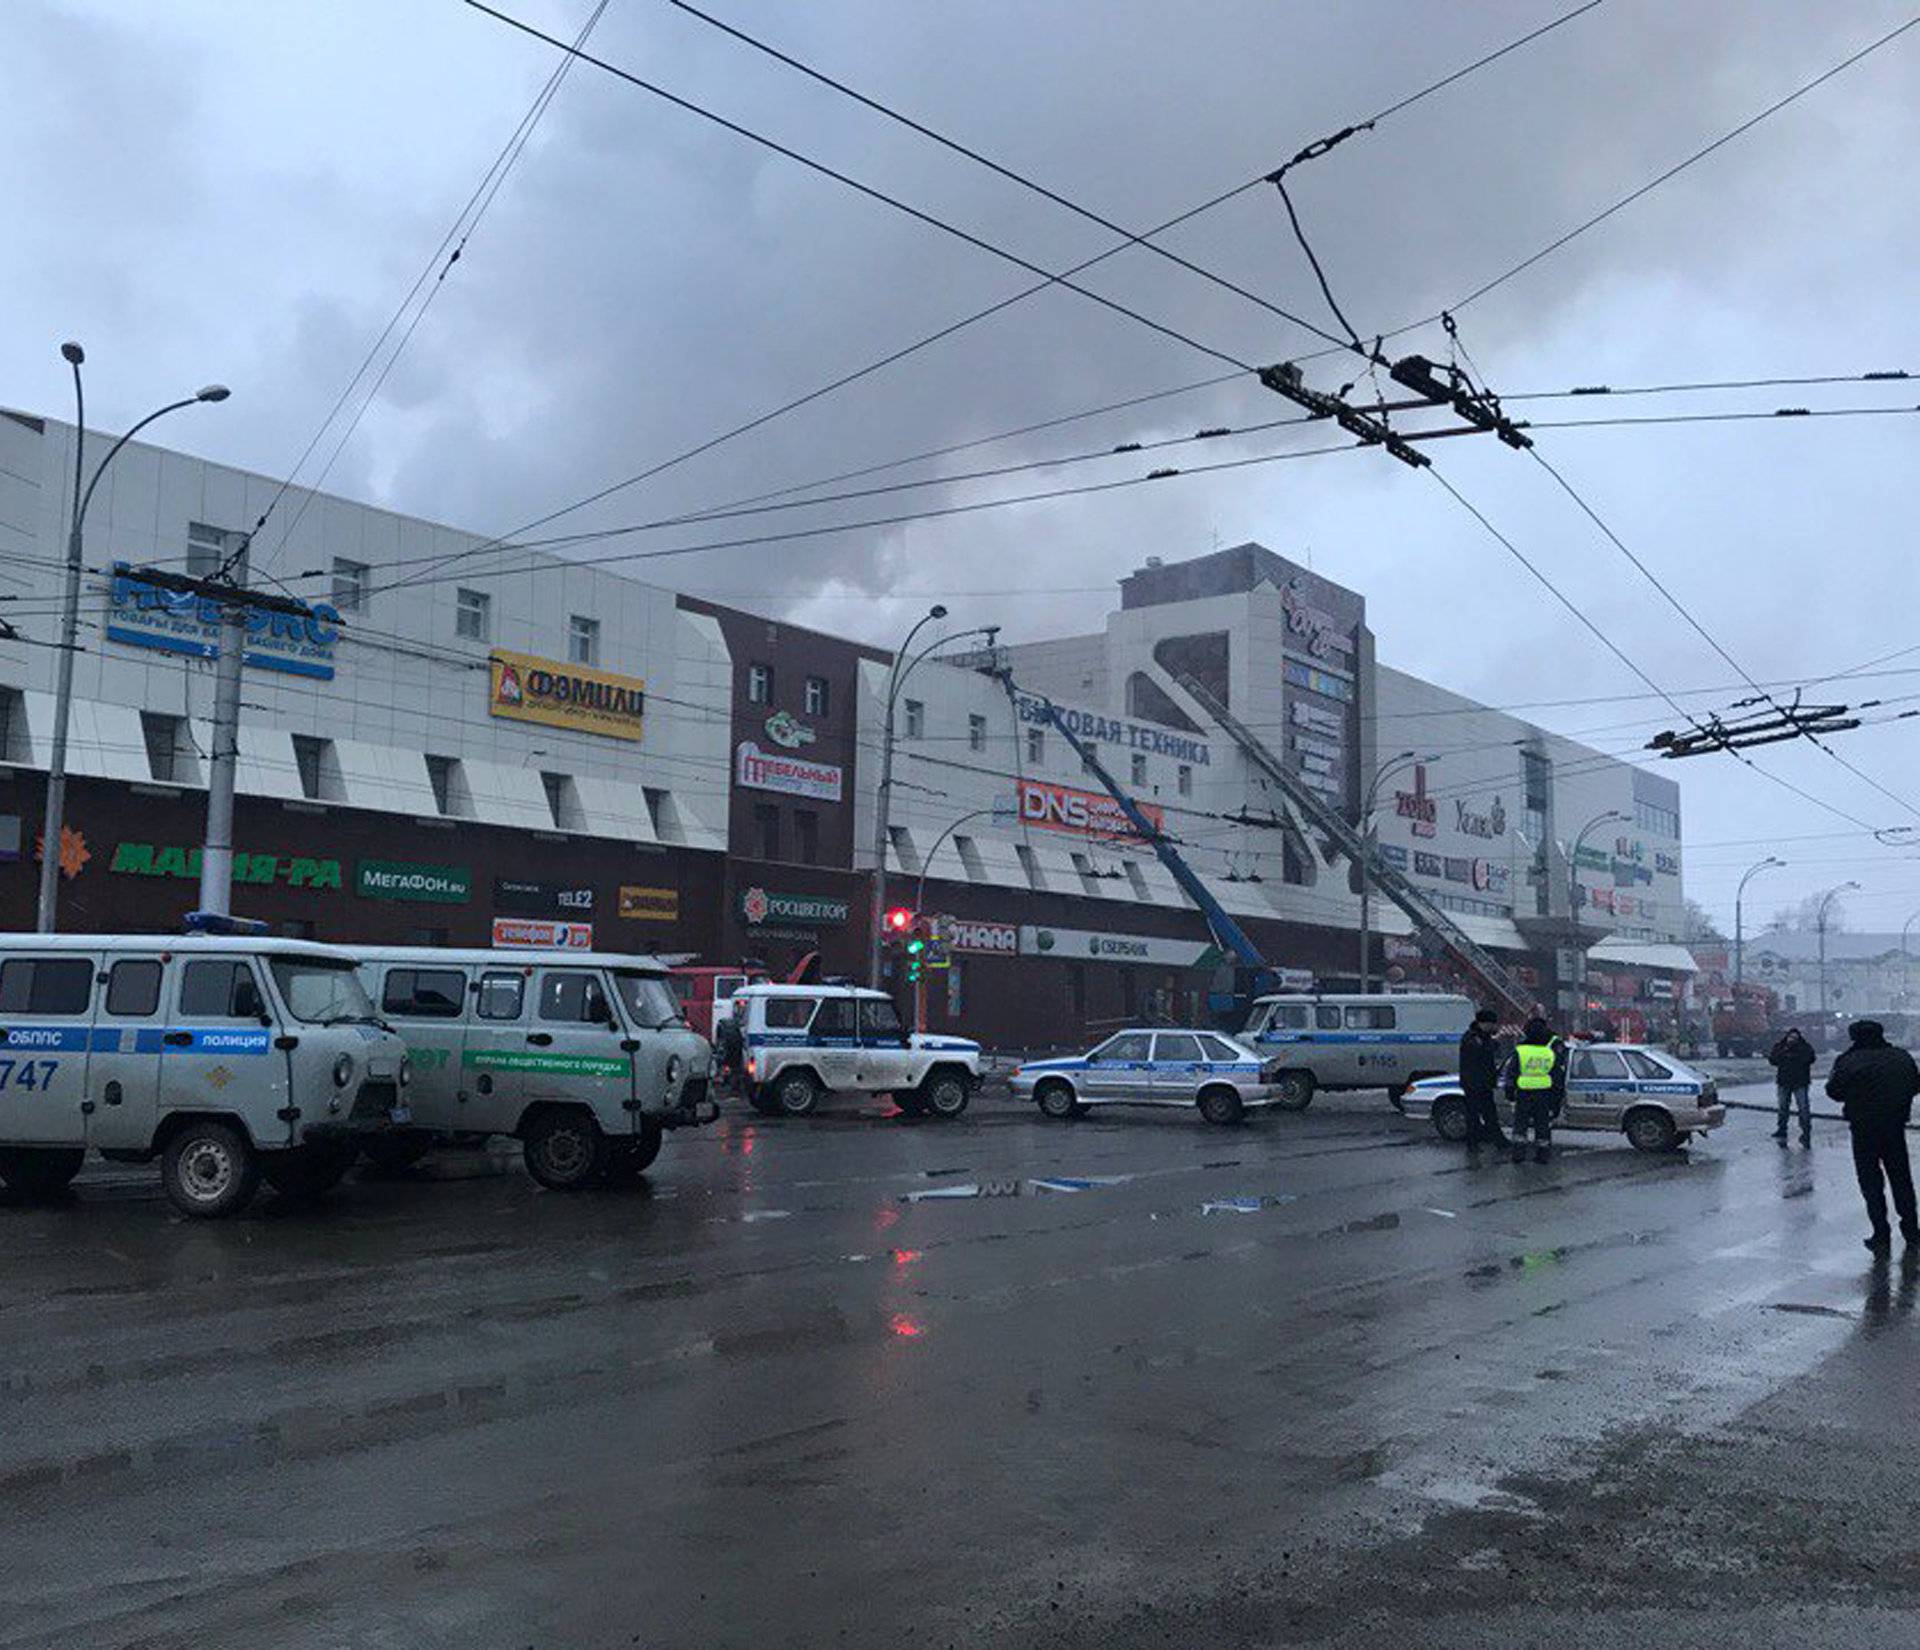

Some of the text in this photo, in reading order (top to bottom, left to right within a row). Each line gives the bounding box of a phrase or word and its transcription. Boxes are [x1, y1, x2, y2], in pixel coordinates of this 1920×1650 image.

[1018, 695, 1211, 767] БТОВАЯ ТЕХНИКА
[1024, 786, 1092, 830] DNS
[110, 843, 342, 890] МАЯ-РА
[558, 889, 592, 909] TELE2
[8, 1031, 62, 1047] ОБППС
[202, 1032, 267, 1049] ПОЛИЦИЯ
